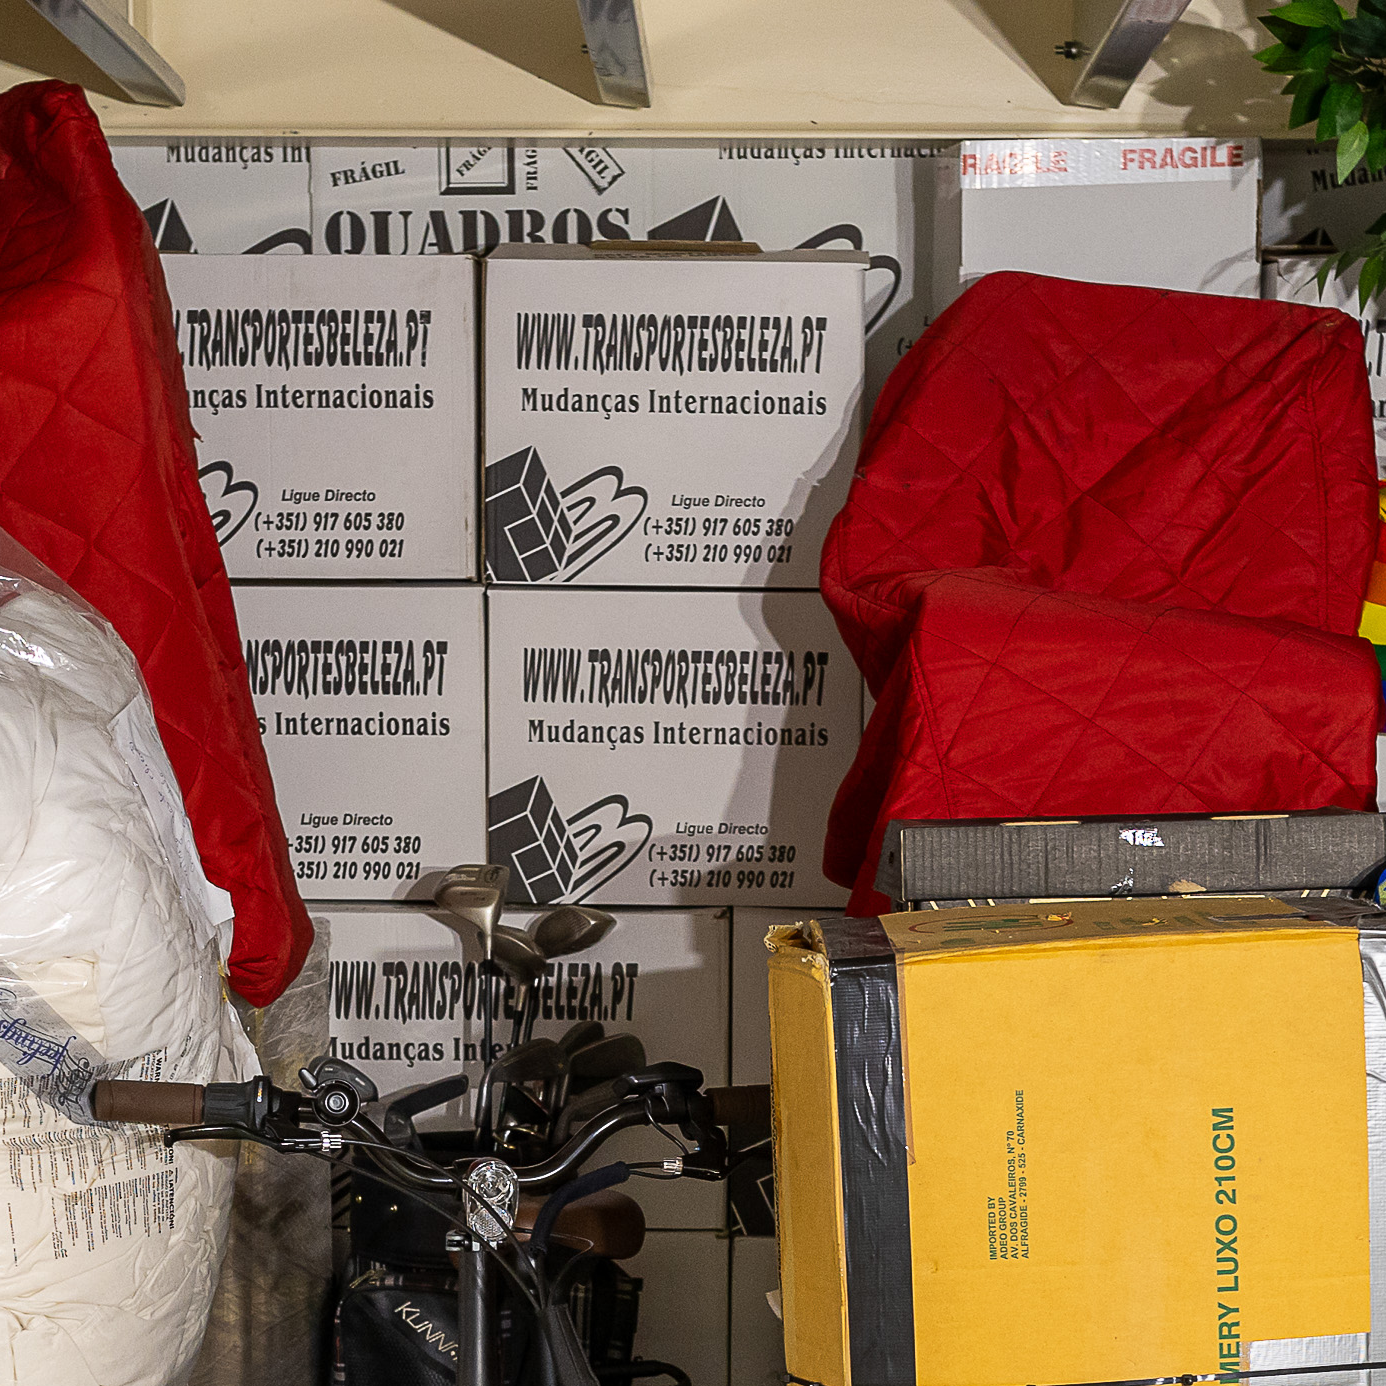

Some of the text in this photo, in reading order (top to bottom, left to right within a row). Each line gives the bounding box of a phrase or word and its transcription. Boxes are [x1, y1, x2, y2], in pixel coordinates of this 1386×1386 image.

[523, 148, 539, 191] FRÁG
[1120, 145, 1245, 172] FRAGILE
[330, 159, 406, 188] FRÁGIL
[325, 207, 630, 257] QUADROS
[174, 309, 433, 371] .TRANSPORTESBELEZA.PT
[516, 312, 828, 376] WWW.TRANSPORTESBELEZA.PT
[255, 383, 435, 409] Internacionais
[520, 387, 828, 420] Mudanças Internacionais
[281, 488, 377, 505] Ligue Directo
[671, 494, 766, 510] Ligue Directo
[254, 511, 405, 532] (+351) 917 605 380
[643, 516, 795, 537] (+351) 917 605 380
[256, 538, 405, 559] (+351) 210 990 021
[644, 543, 793, 564] (+351) 210 990 021
[523, 647, 830, 708] WWW.TRANSPORTESBELEZA.PT
[274, 711, 451, 737] Internacionais
[528, 718, 829, 751] Mudanças Internacionais
[300, 813, 394, 829] Ligue Directo
[675, 822, 769, 837] Ligue Directo
[331, 835, 358, 855] 917
[361, 836, 390, 854] 605
[393, 836, 422, 854] 380
[648, 843, 797, 863] (+351) 917 605 380
[333, 861, 359, 880] 210
[363, 862, 392, 881] 990
[396, 862, 421, 880] 021
[649, 869, 795, 889] (+351) 210 990 021
[1015, 1089, 1024, 1145] CARNAXIDE
[1018, 1152, 1026, 1169] 525
[1211, 1107, 1237, 1205] 210CM
[1008, 1157, 1017, 1219] CAVALEIROS,
[1018, 1177, 1027, 1197] 2799
[987, 1196, 997, 1260] IMPORTED BY
[998, 1197, 1009, 1260] ADEO GROUP
[1009, 1222, 1018, 1241] DOS
[1019, 1205, 1029, 1259] ALFRAGIDE
[1010, 1243, 1019, 1259] AV.
[1215, 1214, 1239, 1293] LUXO
